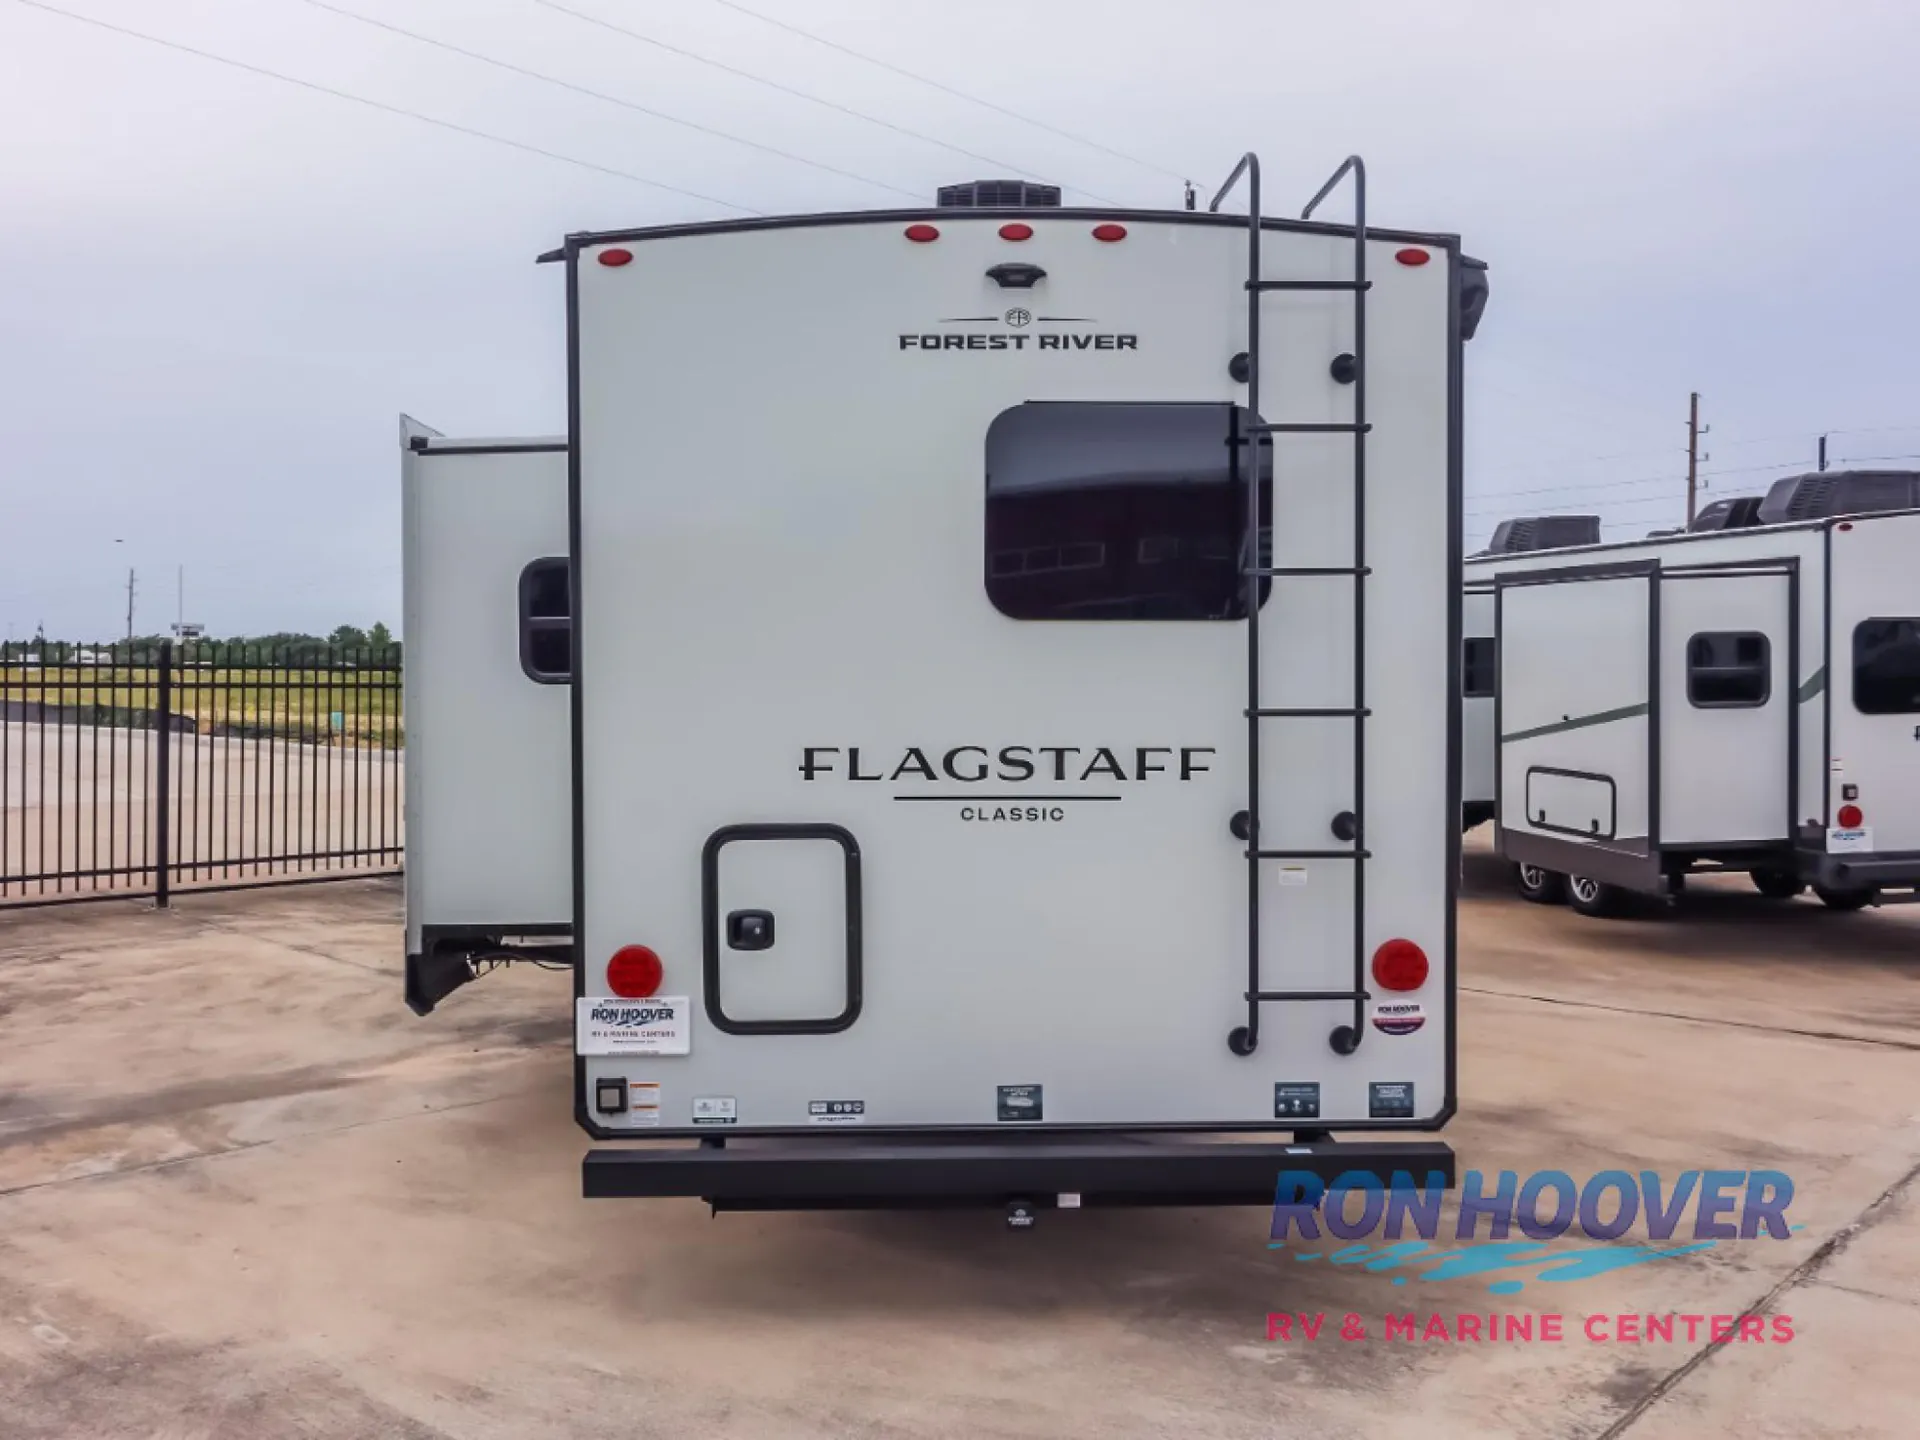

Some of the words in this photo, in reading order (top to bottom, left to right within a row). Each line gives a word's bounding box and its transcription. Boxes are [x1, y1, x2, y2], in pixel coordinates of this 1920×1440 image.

[898, 334, 1030, 350] FOREST
[1038, 334, 1138, 350] RIVER
[799, 746, 1216, 781] FLAGSTAFF
[961, 806, 1065, 822] CLASSIC
[591, 1008, 619, 1021] RON
[620, 1008, 674, 1021] HOOVER
